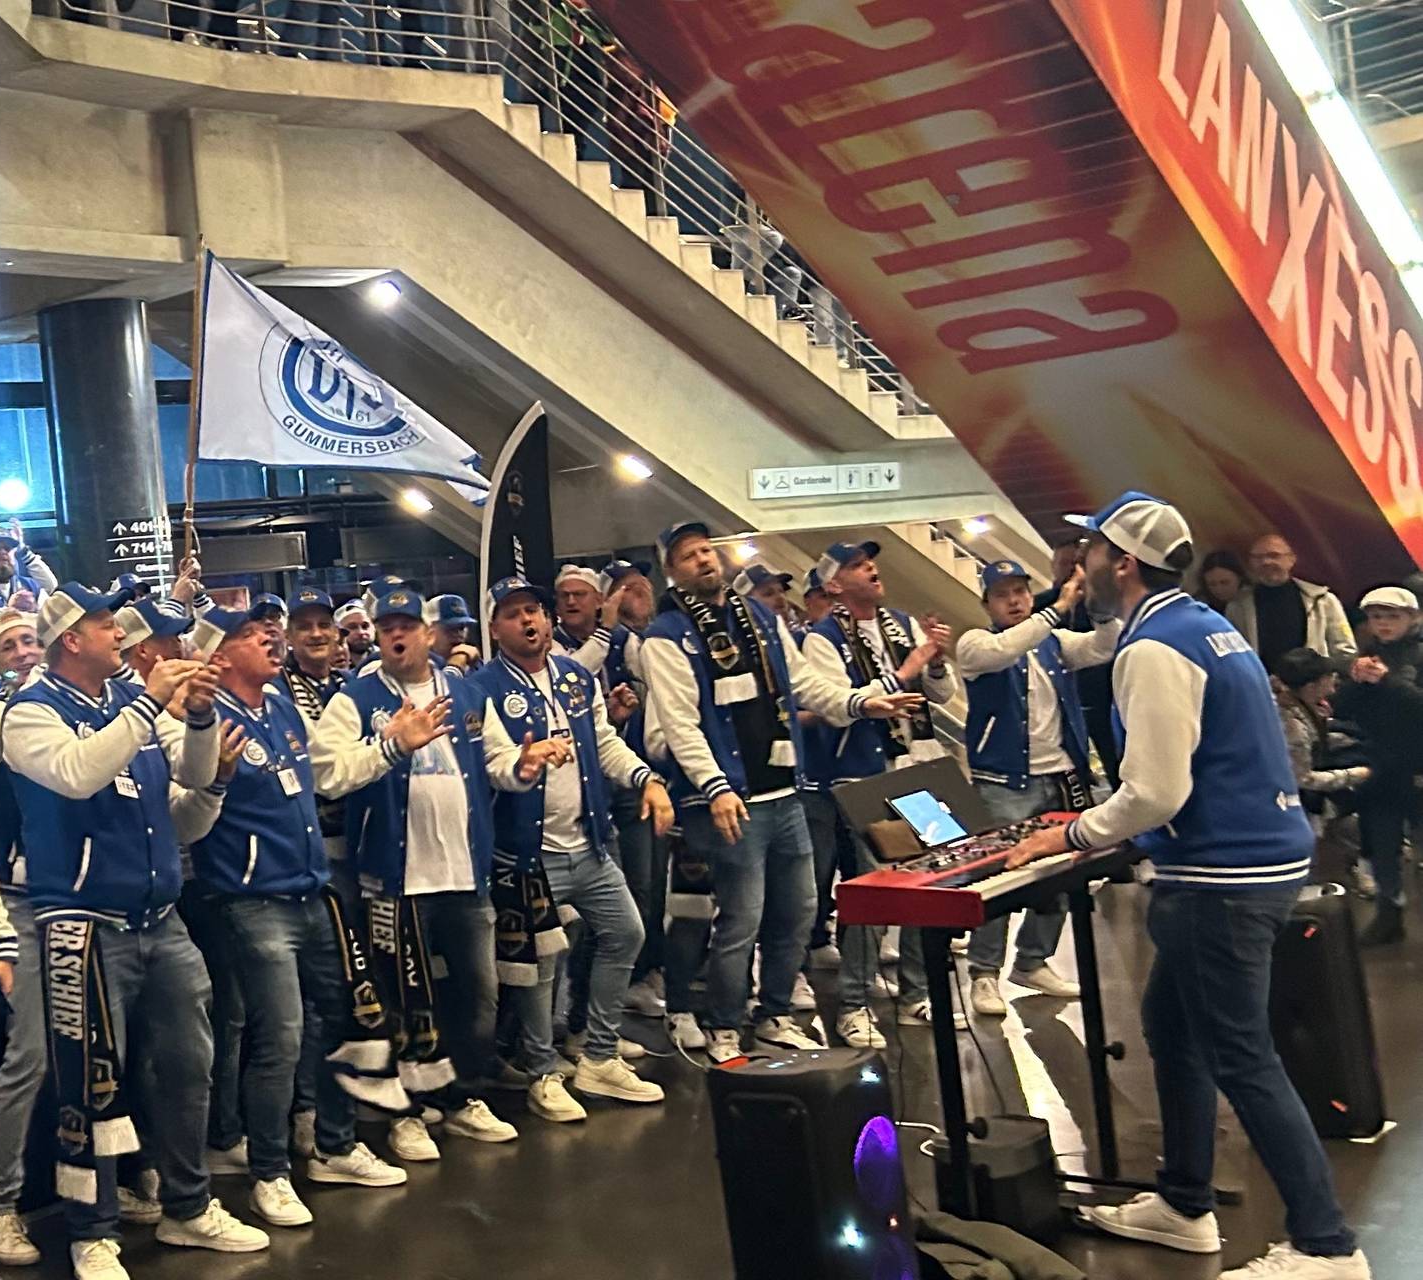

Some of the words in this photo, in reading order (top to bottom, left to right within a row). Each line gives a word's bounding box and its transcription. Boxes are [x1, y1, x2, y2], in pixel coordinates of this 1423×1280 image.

[282, 414, 420, 455] GUMMERSBACH
[793, 476, 832, 486] Garderobe
[371, 898, 395, 955] HIEF
[49, 950, 83, 1041] SCHIEF
